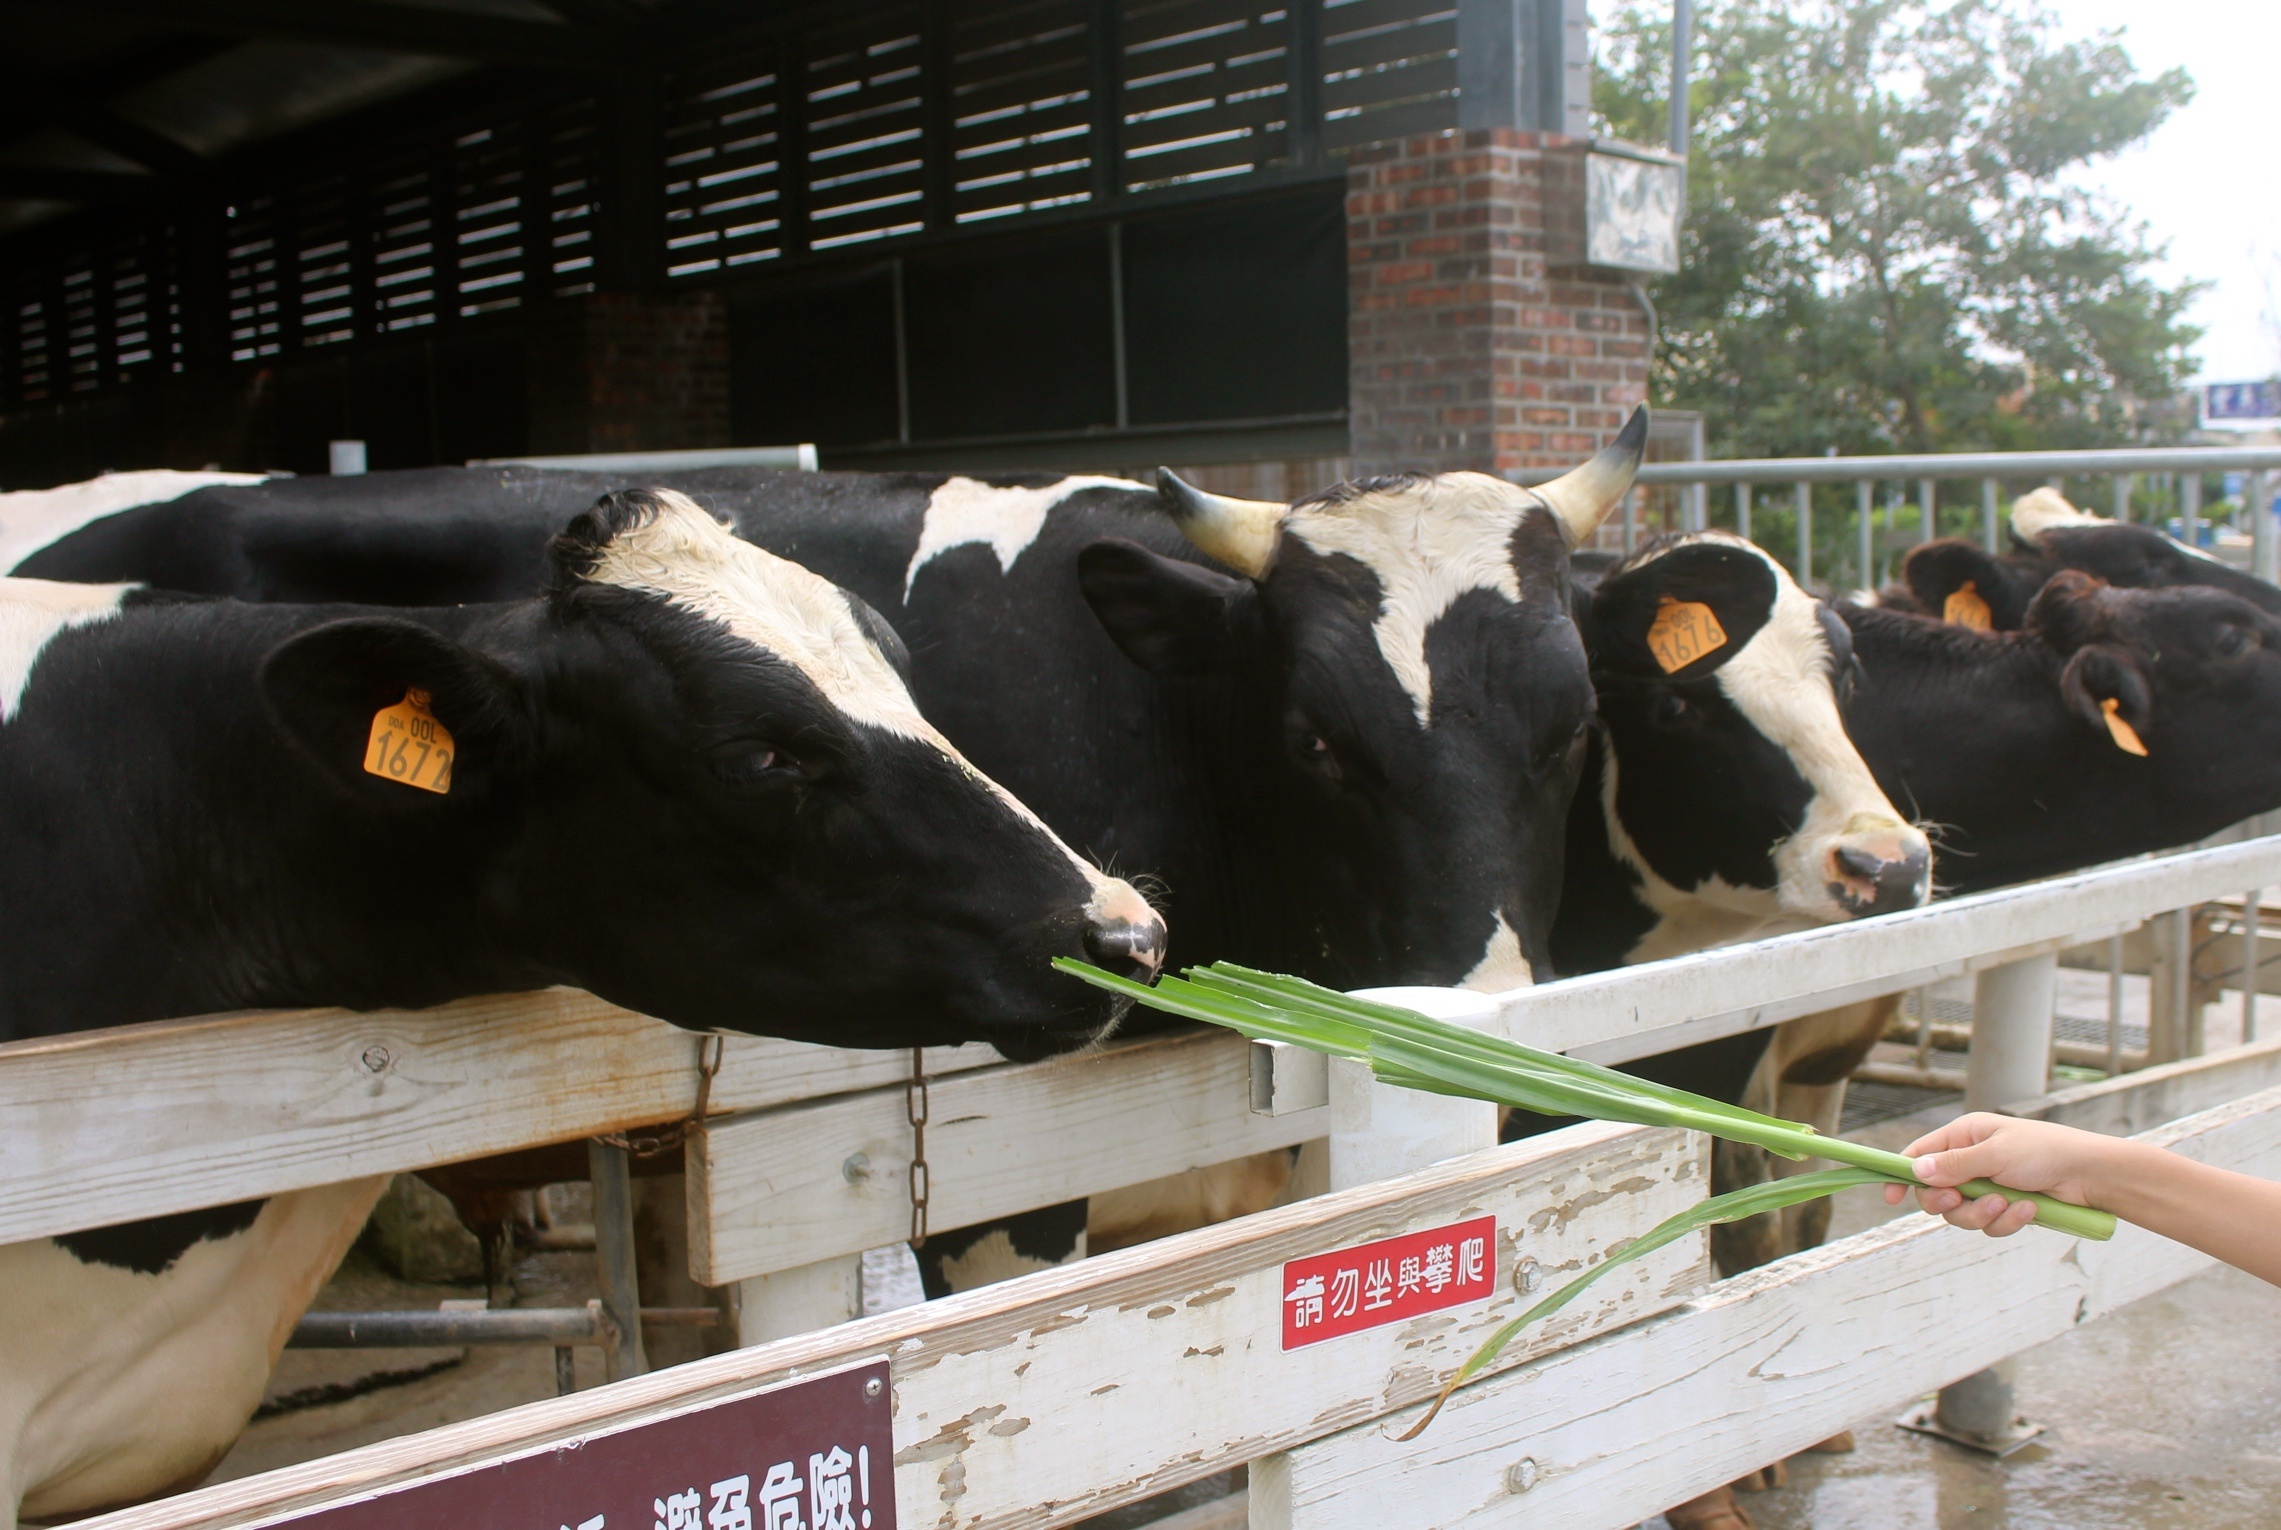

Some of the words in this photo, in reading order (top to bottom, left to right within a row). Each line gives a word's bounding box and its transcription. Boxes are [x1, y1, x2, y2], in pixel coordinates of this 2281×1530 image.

[1660, 614, 1722, 667] 1676
[377, 730, 452, 791] 1672
[1285, 1237, 1484, 1328] 請勿坐與攀爬
